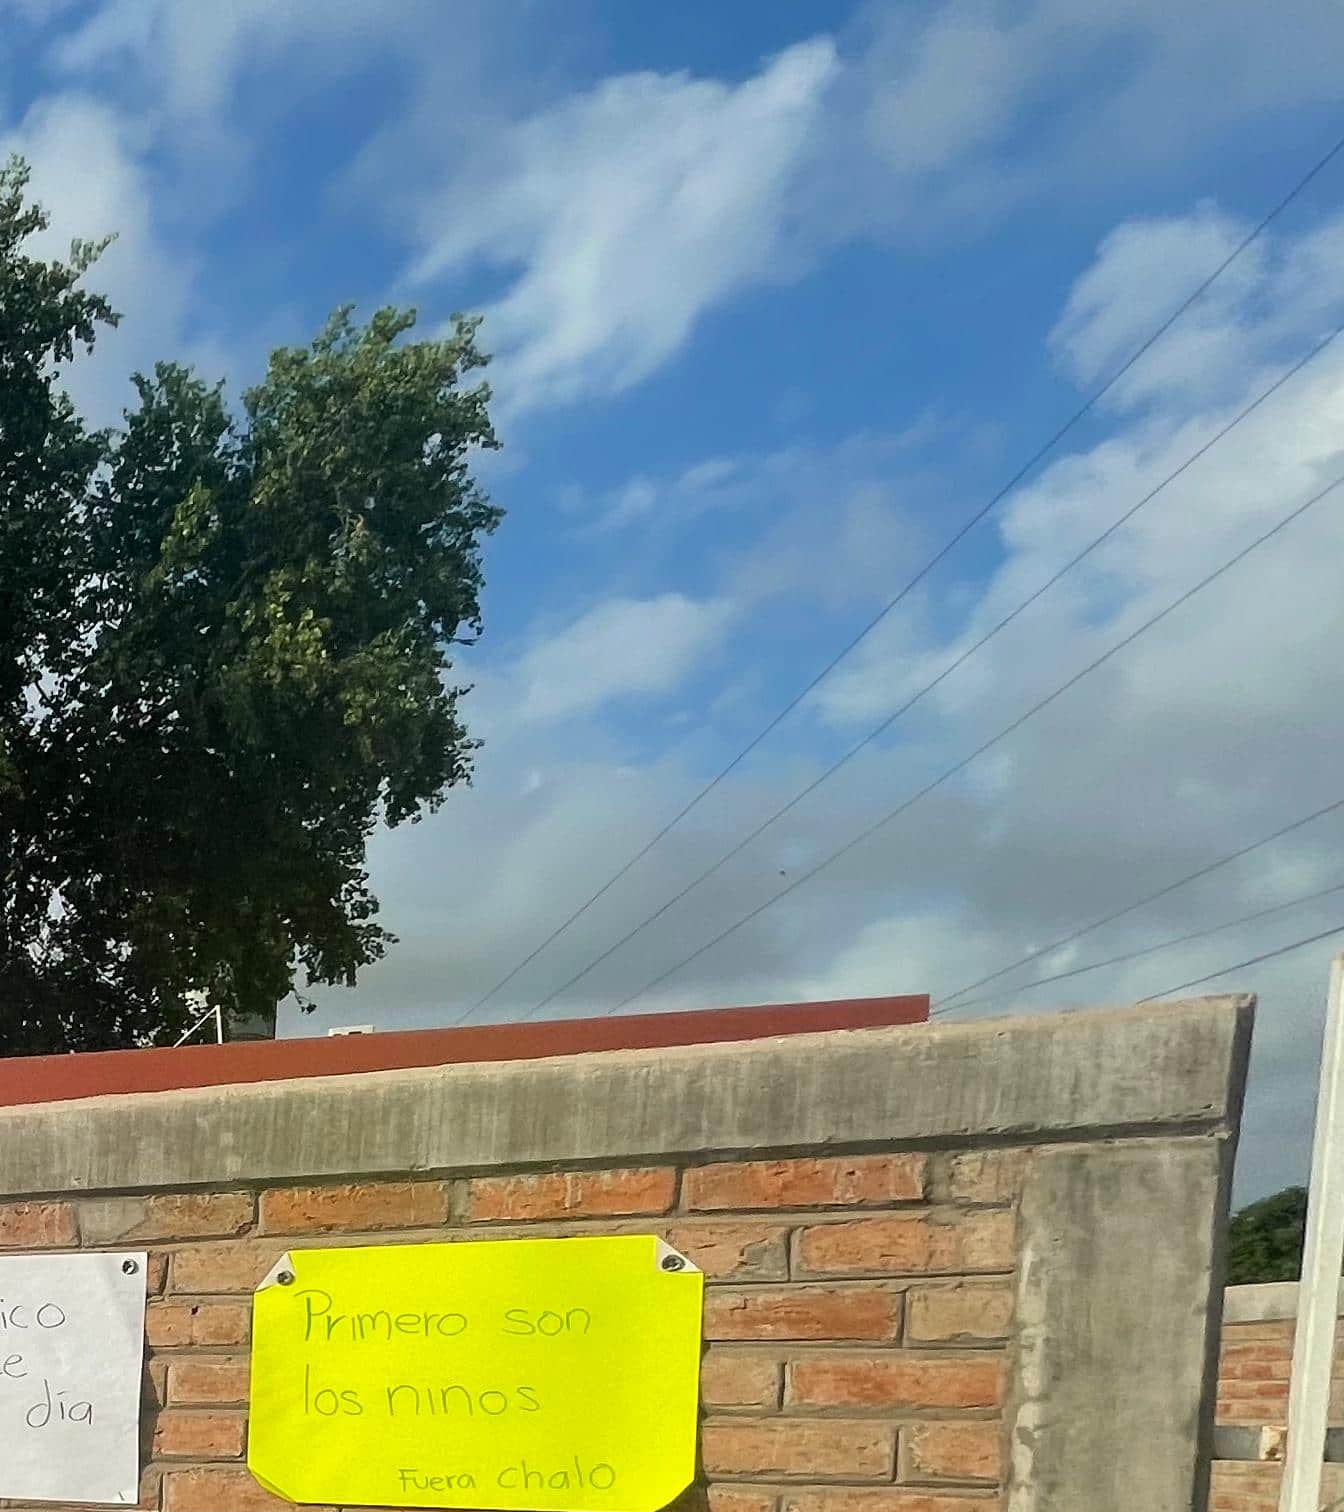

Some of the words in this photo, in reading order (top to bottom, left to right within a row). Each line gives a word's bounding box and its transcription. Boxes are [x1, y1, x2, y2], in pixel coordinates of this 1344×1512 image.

[294, 1289, 468, 1342] Primero
[504, 1305, 591, 1337] son
[304, 1363, 363, 1417] los
[397, 1468, 476, 1493] Fuera
[496, 1455, 617, 1491] chalo
